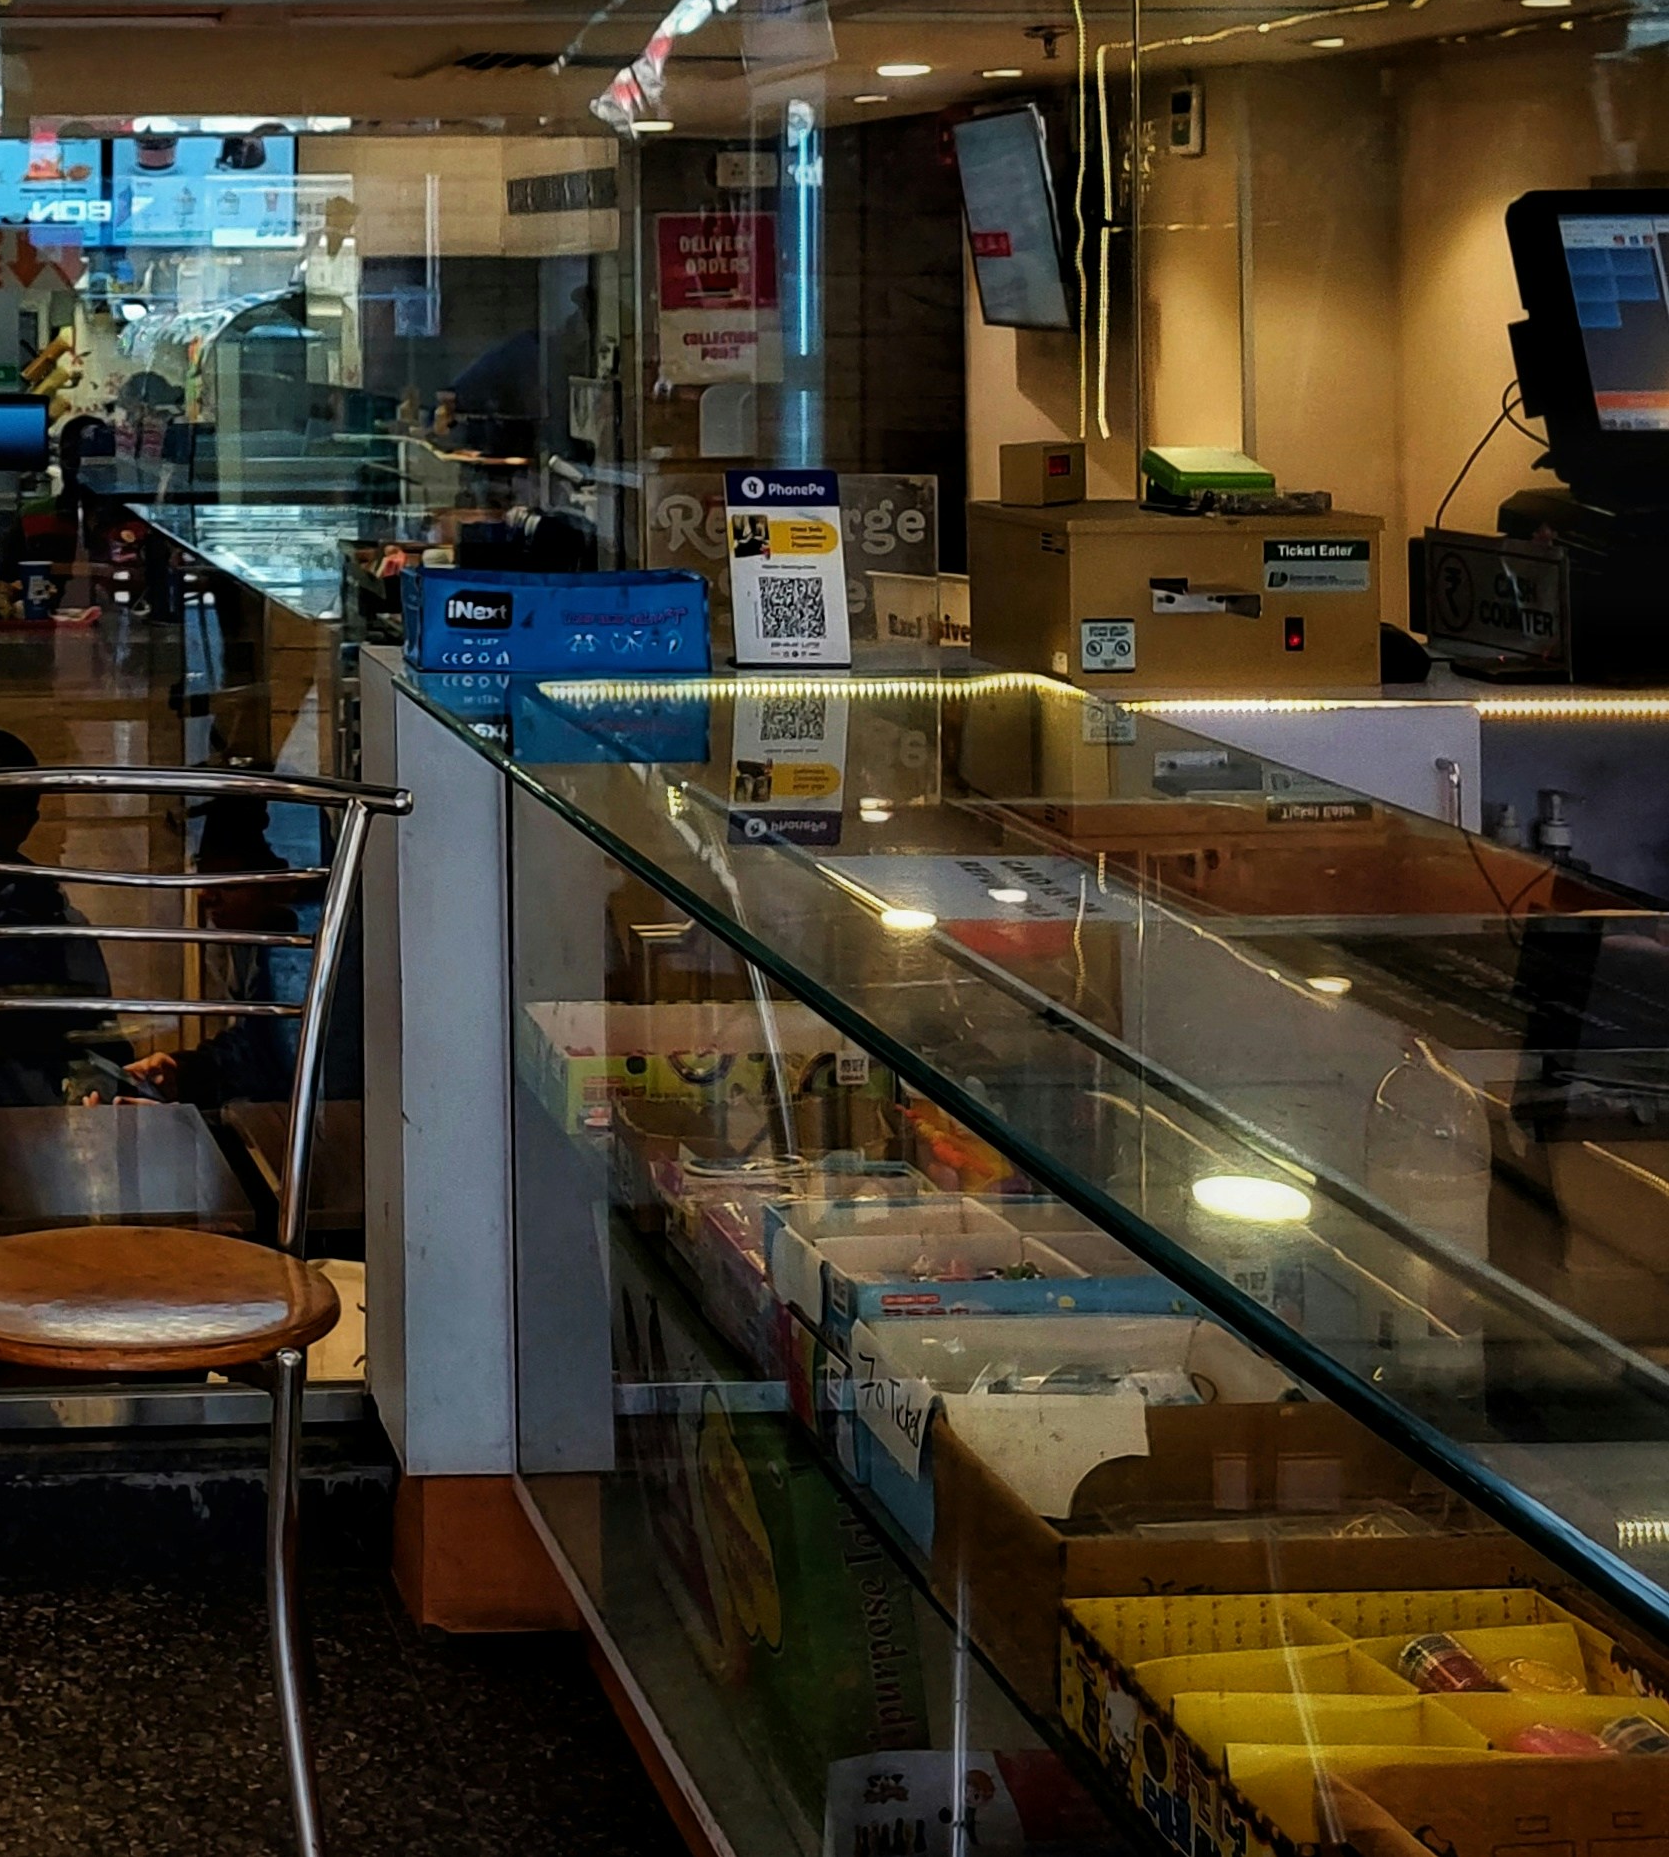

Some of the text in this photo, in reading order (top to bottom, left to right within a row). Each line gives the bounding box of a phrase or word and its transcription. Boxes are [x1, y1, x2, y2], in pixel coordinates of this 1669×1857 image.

[678, 235, 752, 254] DELIVER
[684, 257, 750, 274] ORDERS
[768, 483, 826, 497] PhonePe
[657, 494, 927, 559] Rerge
[1277, 544, 1316, 558] Ticket
[447, 599, 507, 622] iNext
